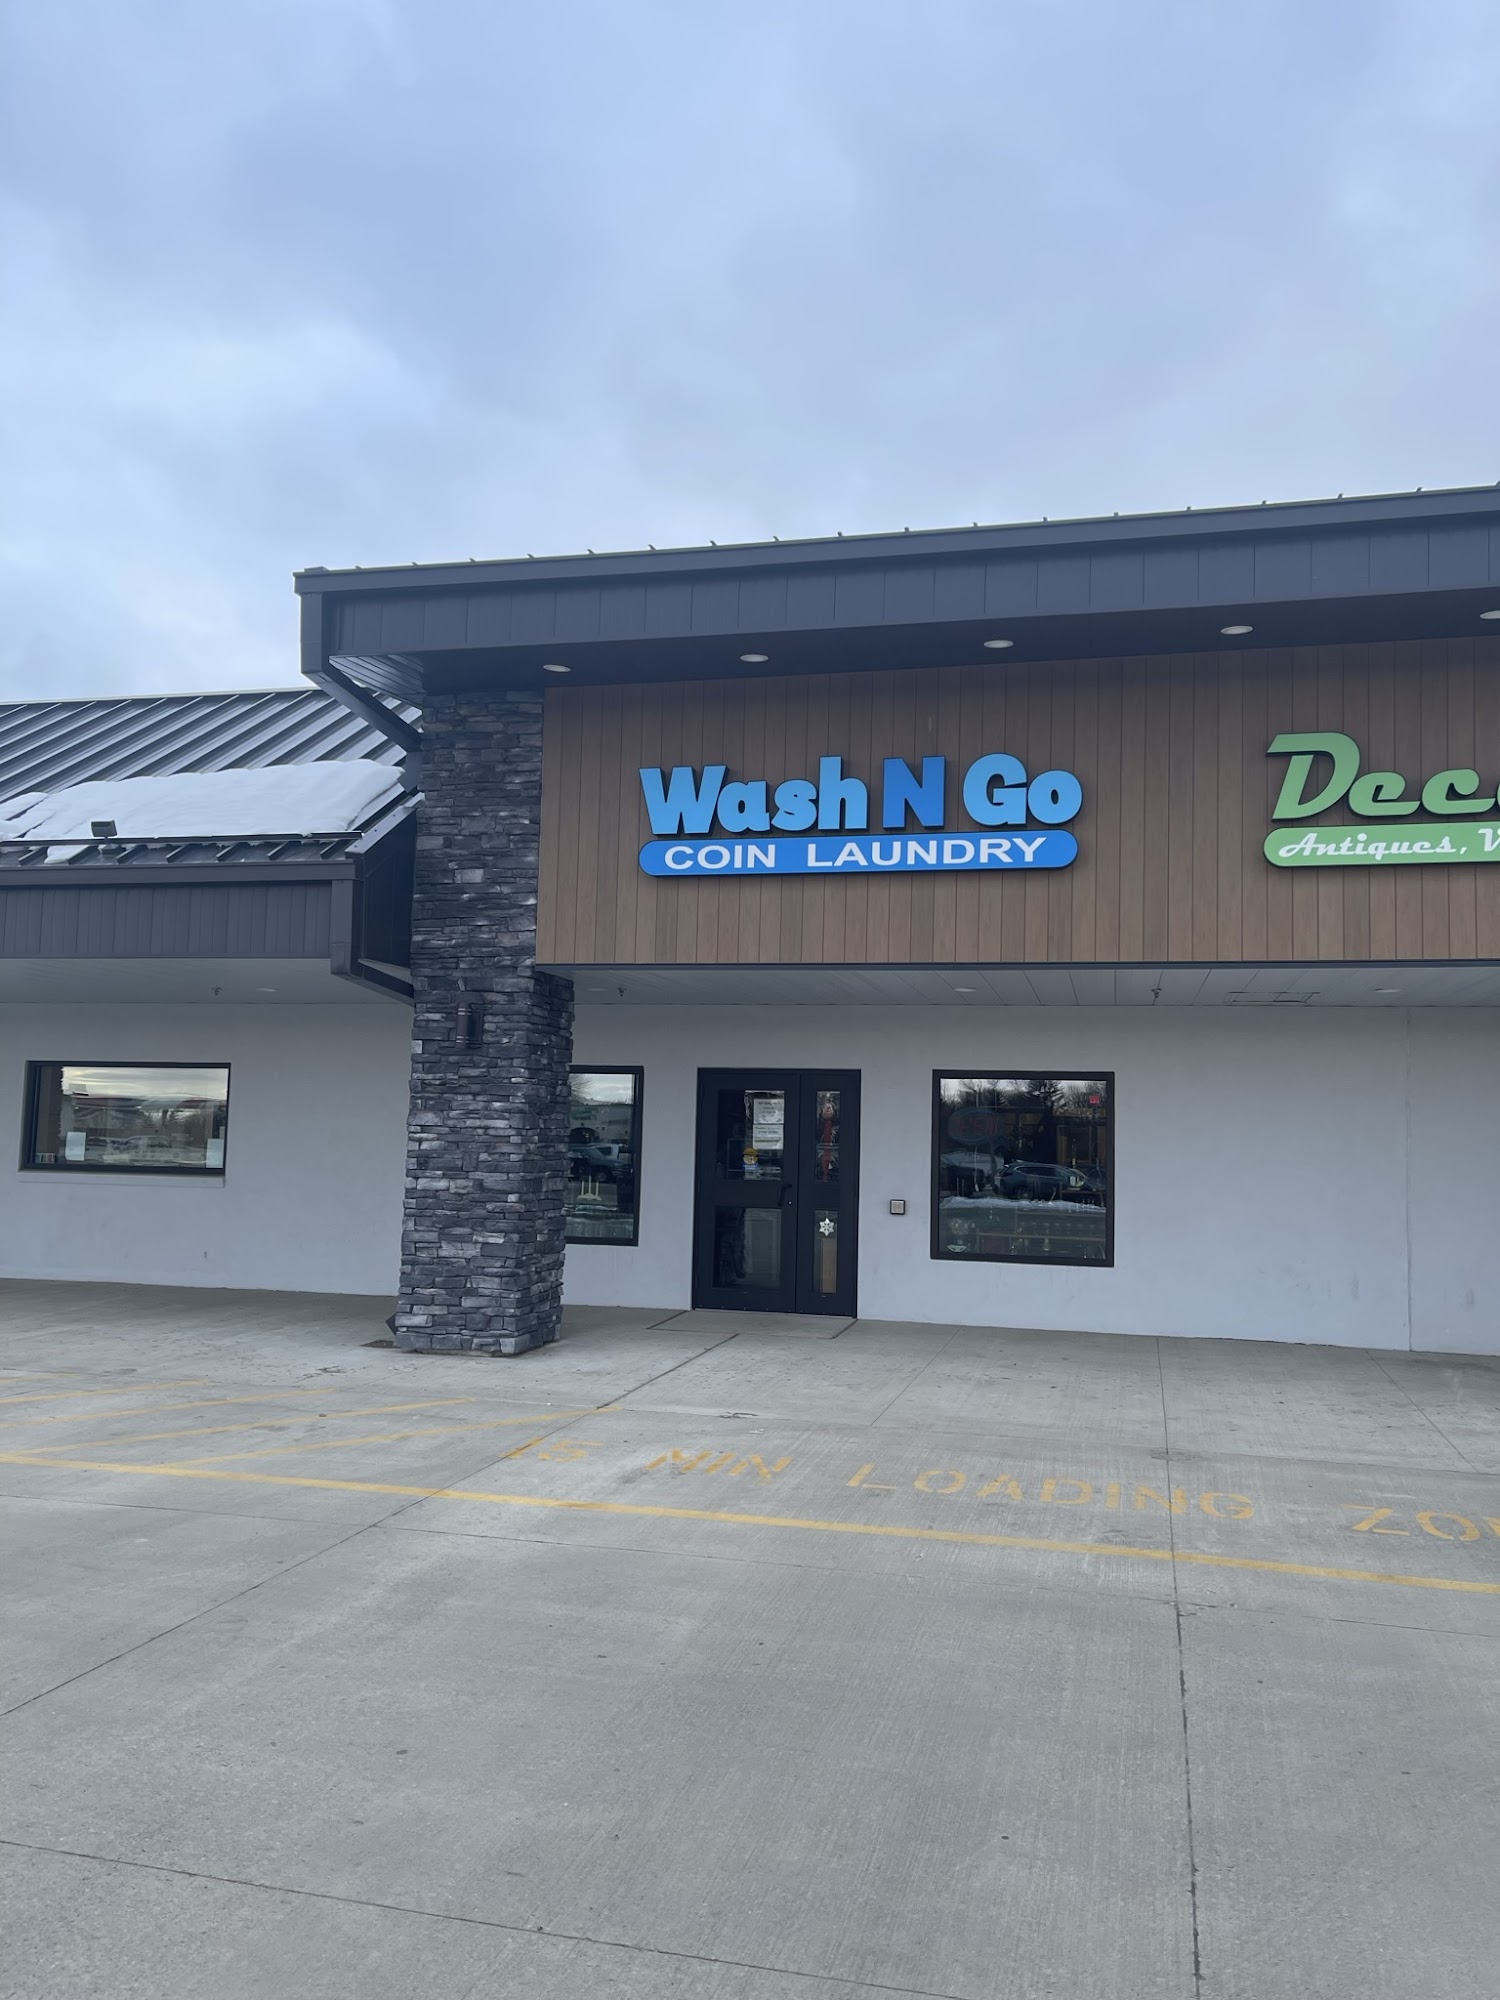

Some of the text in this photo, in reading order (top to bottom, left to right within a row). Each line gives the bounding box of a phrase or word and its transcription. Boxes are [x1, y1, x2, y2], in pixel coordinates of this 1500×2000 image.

[638, 753, 1083, 835] Wash N Go
[1266, 732, 1500, 819] Dec
[664, 837, 1047, 870] COIN LAUNDRY
[1278, 832, 1468, 861] Antiques,
[646, 1448, 793, 1486] MIN
[846, 1462, 1256, 1521] LOADING
[1341, 1504, 1500, 1541] ZO
